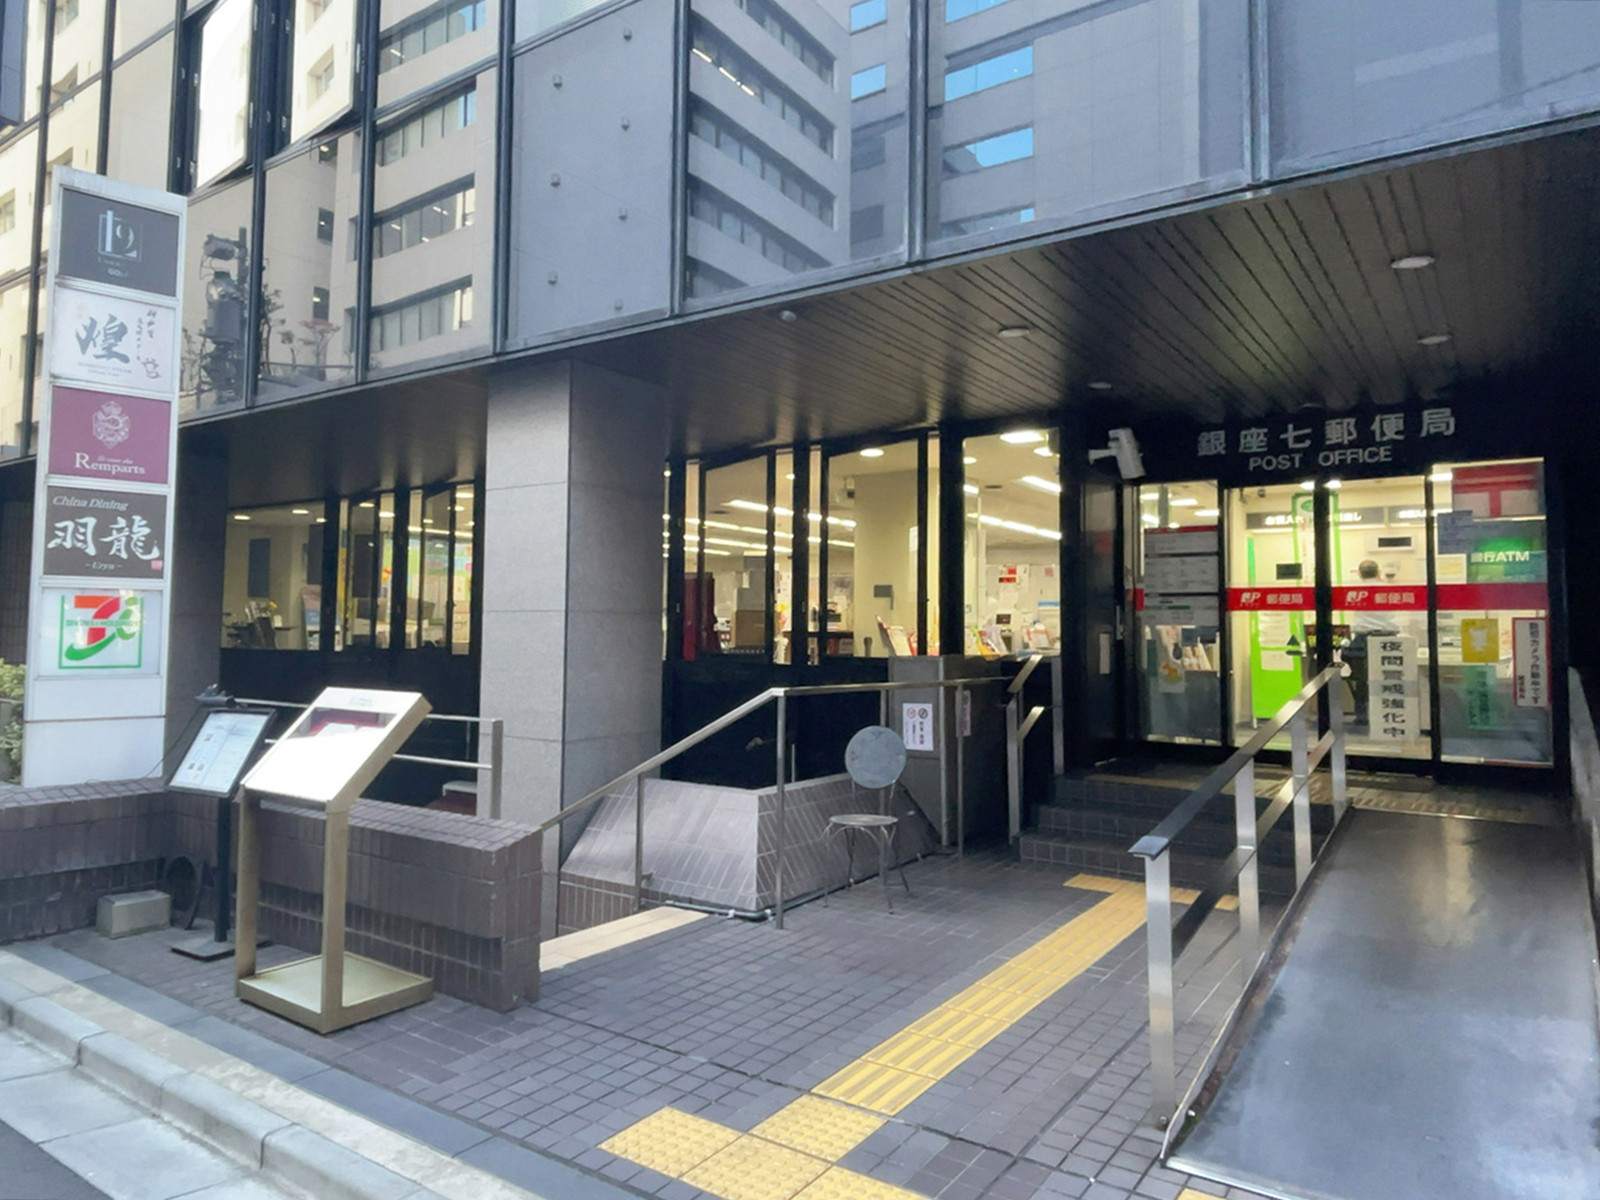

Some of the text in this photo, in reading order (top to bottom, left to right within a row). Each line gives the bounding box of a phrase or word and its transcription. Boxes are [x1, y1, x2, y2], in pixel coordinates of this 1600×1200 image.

[75, 313, 131, 364] 煌
[1197, 407, 1456, 457] 銀座七郵便局
[75, 452, 146, 475] Remparts
[1248, 446, 1393, 471] POST OFFICE
[53, 496, 128, 511] China Dining
[47, 515, 160, 560] 羽龍
